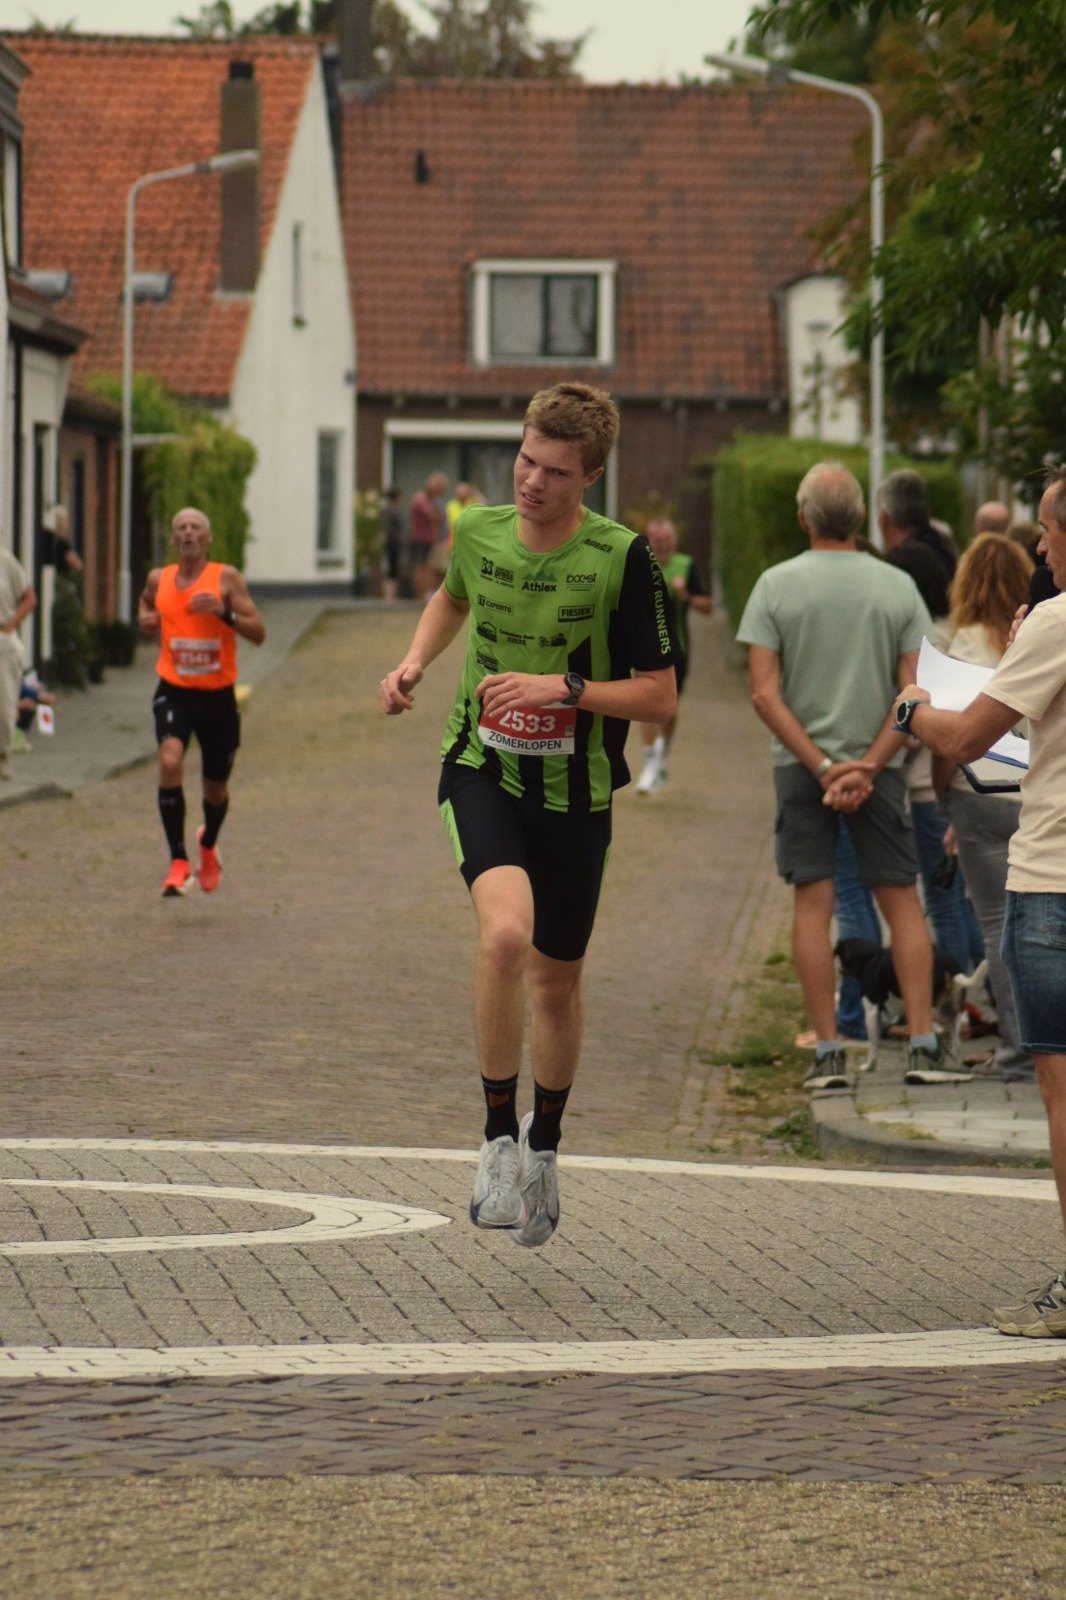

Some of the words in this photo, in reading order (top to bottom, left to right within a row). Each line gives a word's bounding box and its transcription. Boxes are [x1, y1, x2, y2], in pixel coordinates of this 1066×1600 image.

[521, 581, 557, 592] Athlex
[486, 600, 512, 613] EXPERTS
[654, 590, 672, 655] RUNNERS
[488, 731, 561, 750] ZOMERLOPEN
